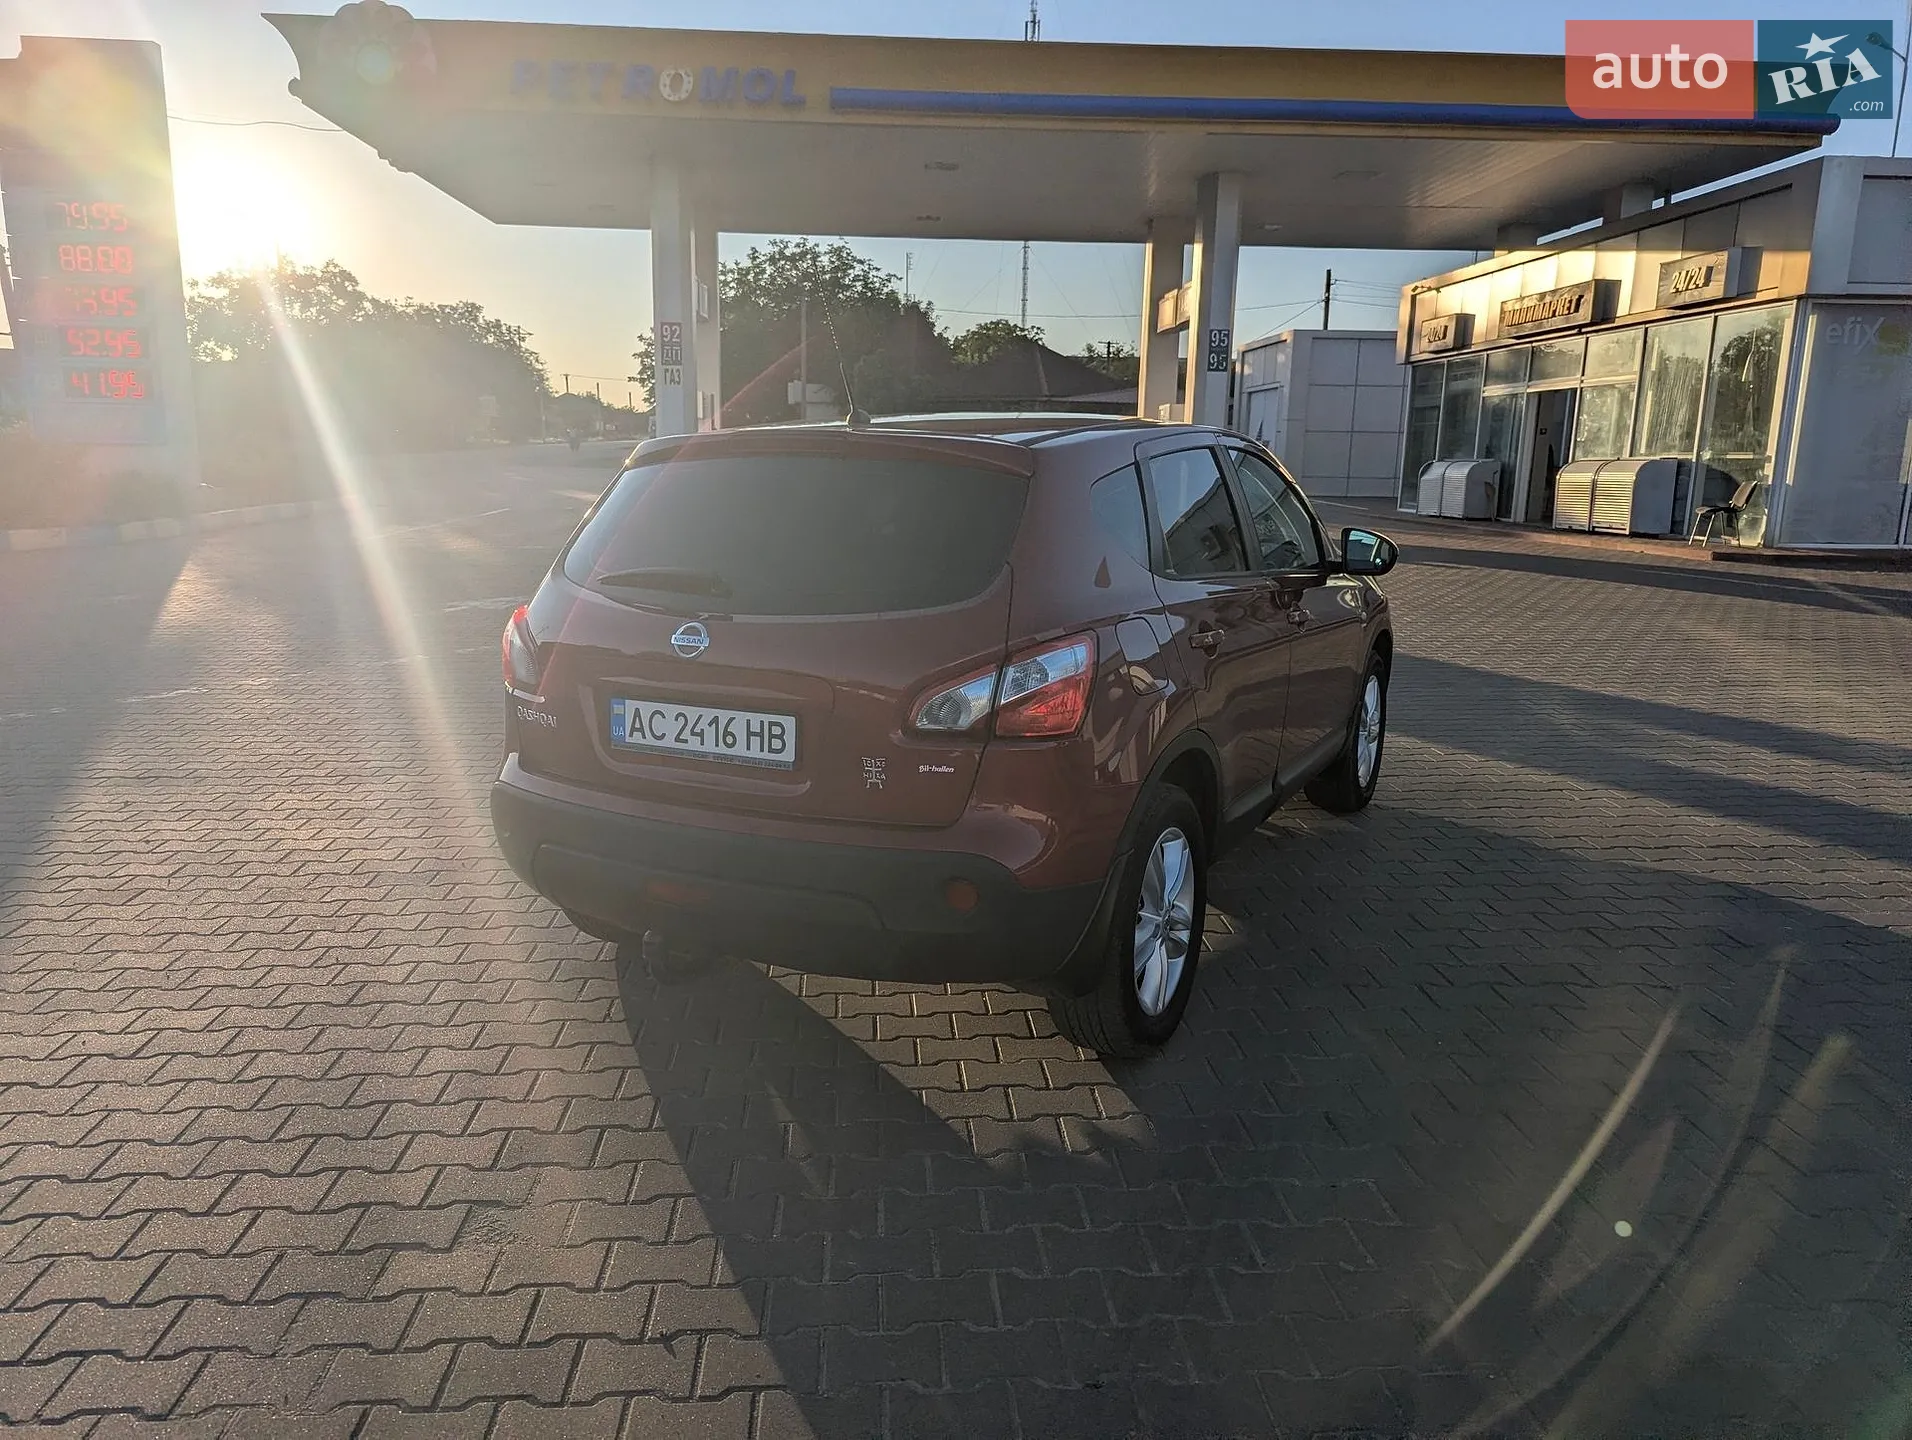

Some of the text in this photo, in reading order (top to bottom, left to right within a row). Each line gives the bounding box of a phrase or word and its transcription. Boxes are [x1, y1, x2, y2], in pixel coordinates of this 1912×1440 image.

[511, 59, 806, 106] PETROMOL
[662, 325, 681, 342] 92
[1210, 330, 1228, 347] 95
[663, 368, 681, 385] ГАЗ
[674, 636, 704, 645] NISSAN
[612, 725, 625, 736] UA
[628, 707, 787, 755] AC 2416 HB
